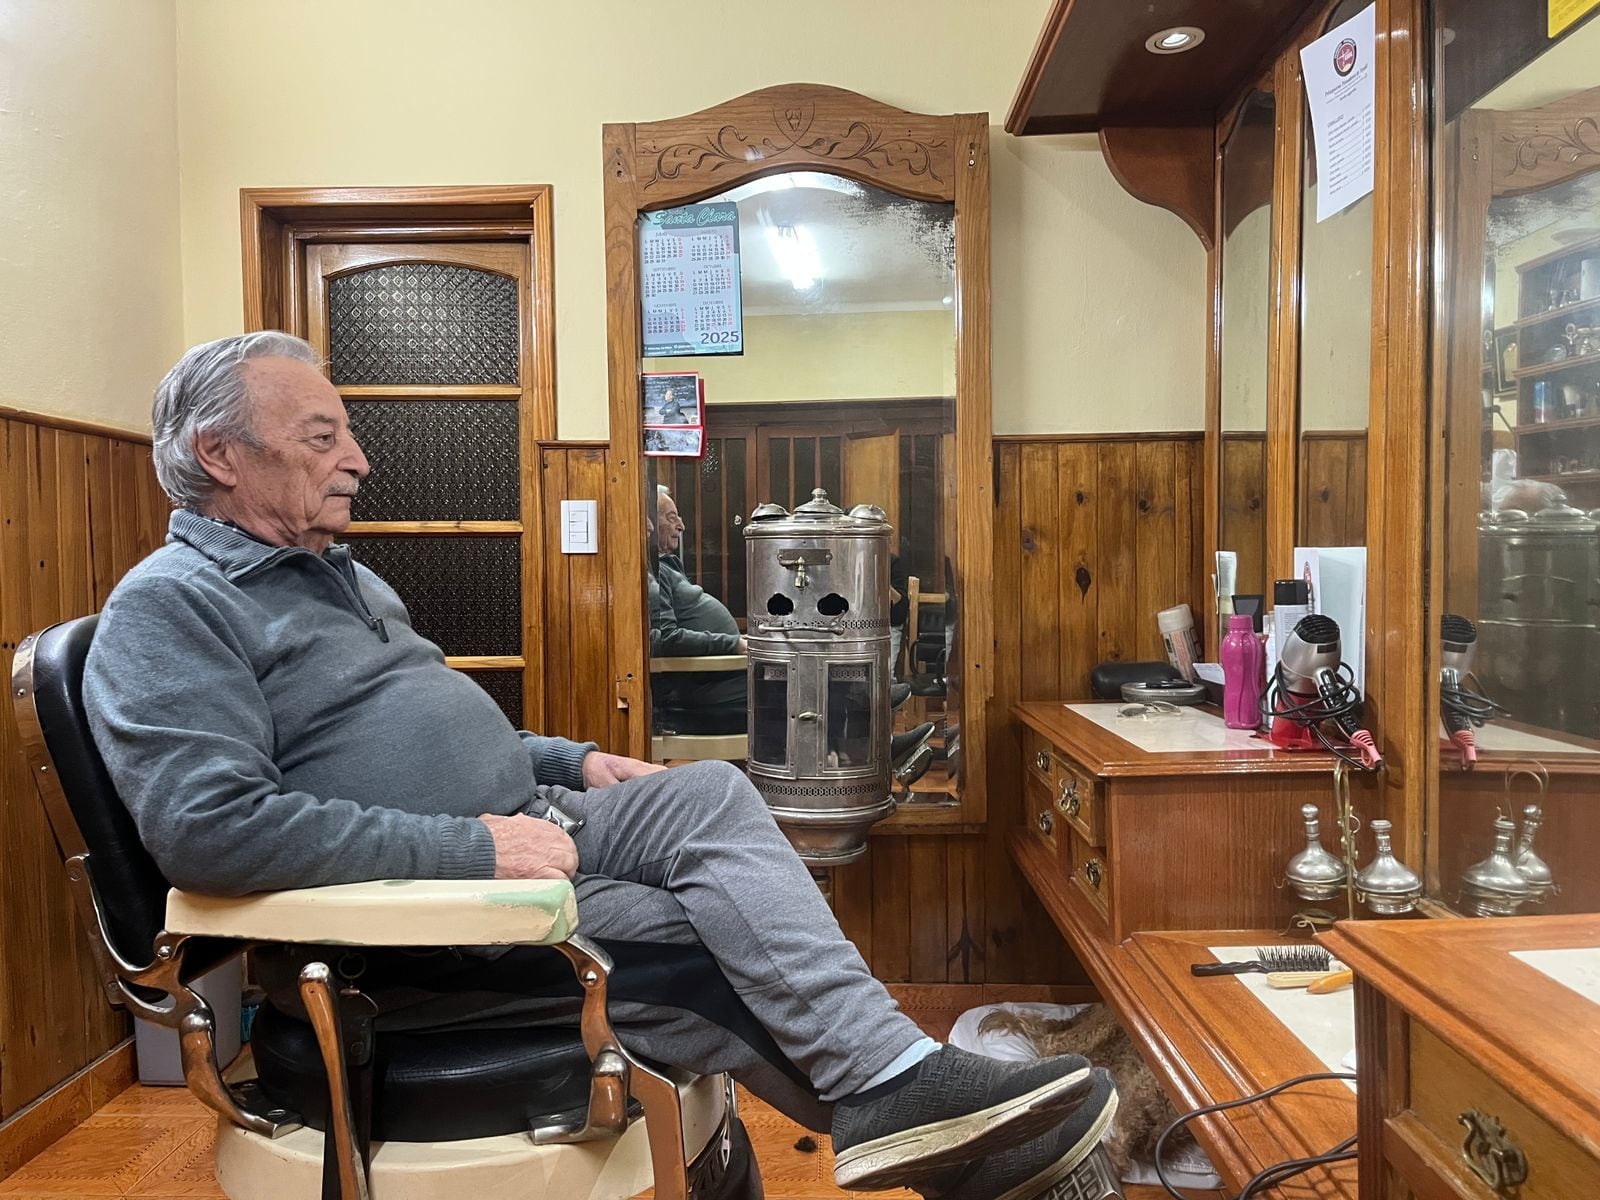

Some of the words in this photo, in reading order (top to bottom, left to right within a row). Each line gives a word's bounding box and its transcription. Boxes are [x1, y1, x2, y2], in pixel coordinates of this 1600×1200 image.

[653, 210, 696, 226] Santa
[695, 206, 736, 227] Clara
[700, 330, 740, 345] 2025
